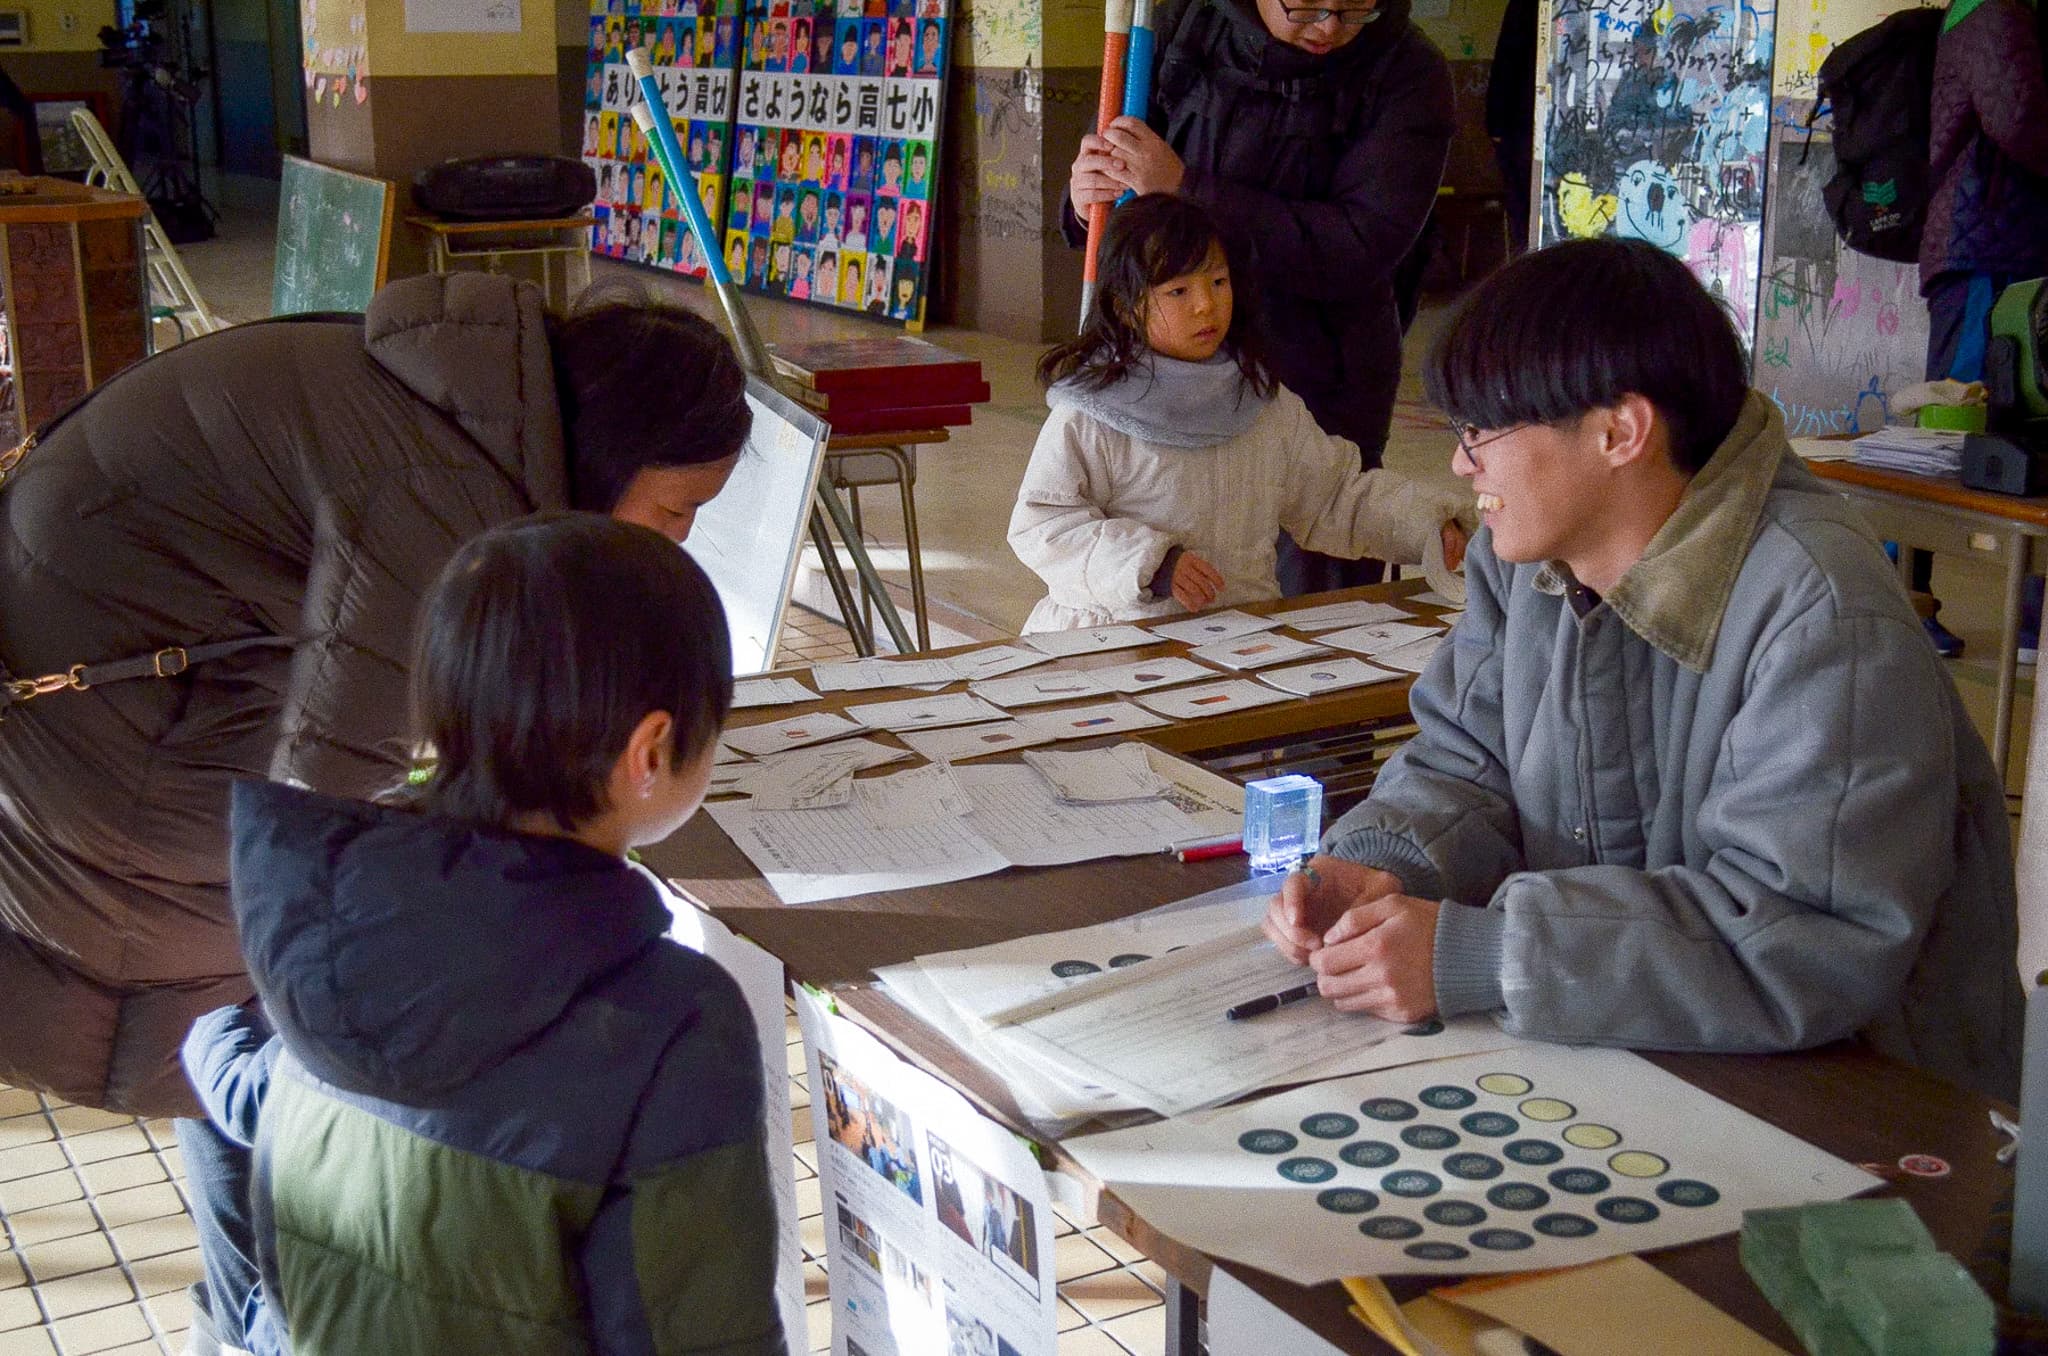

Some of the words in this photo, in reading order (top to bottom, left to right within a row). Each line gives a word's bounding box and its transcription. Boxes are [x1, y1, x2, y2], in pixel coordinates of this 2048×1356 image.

[745, 78, 934, 132] さようなら高七小
[931, 1147, 953, 1184] 03
